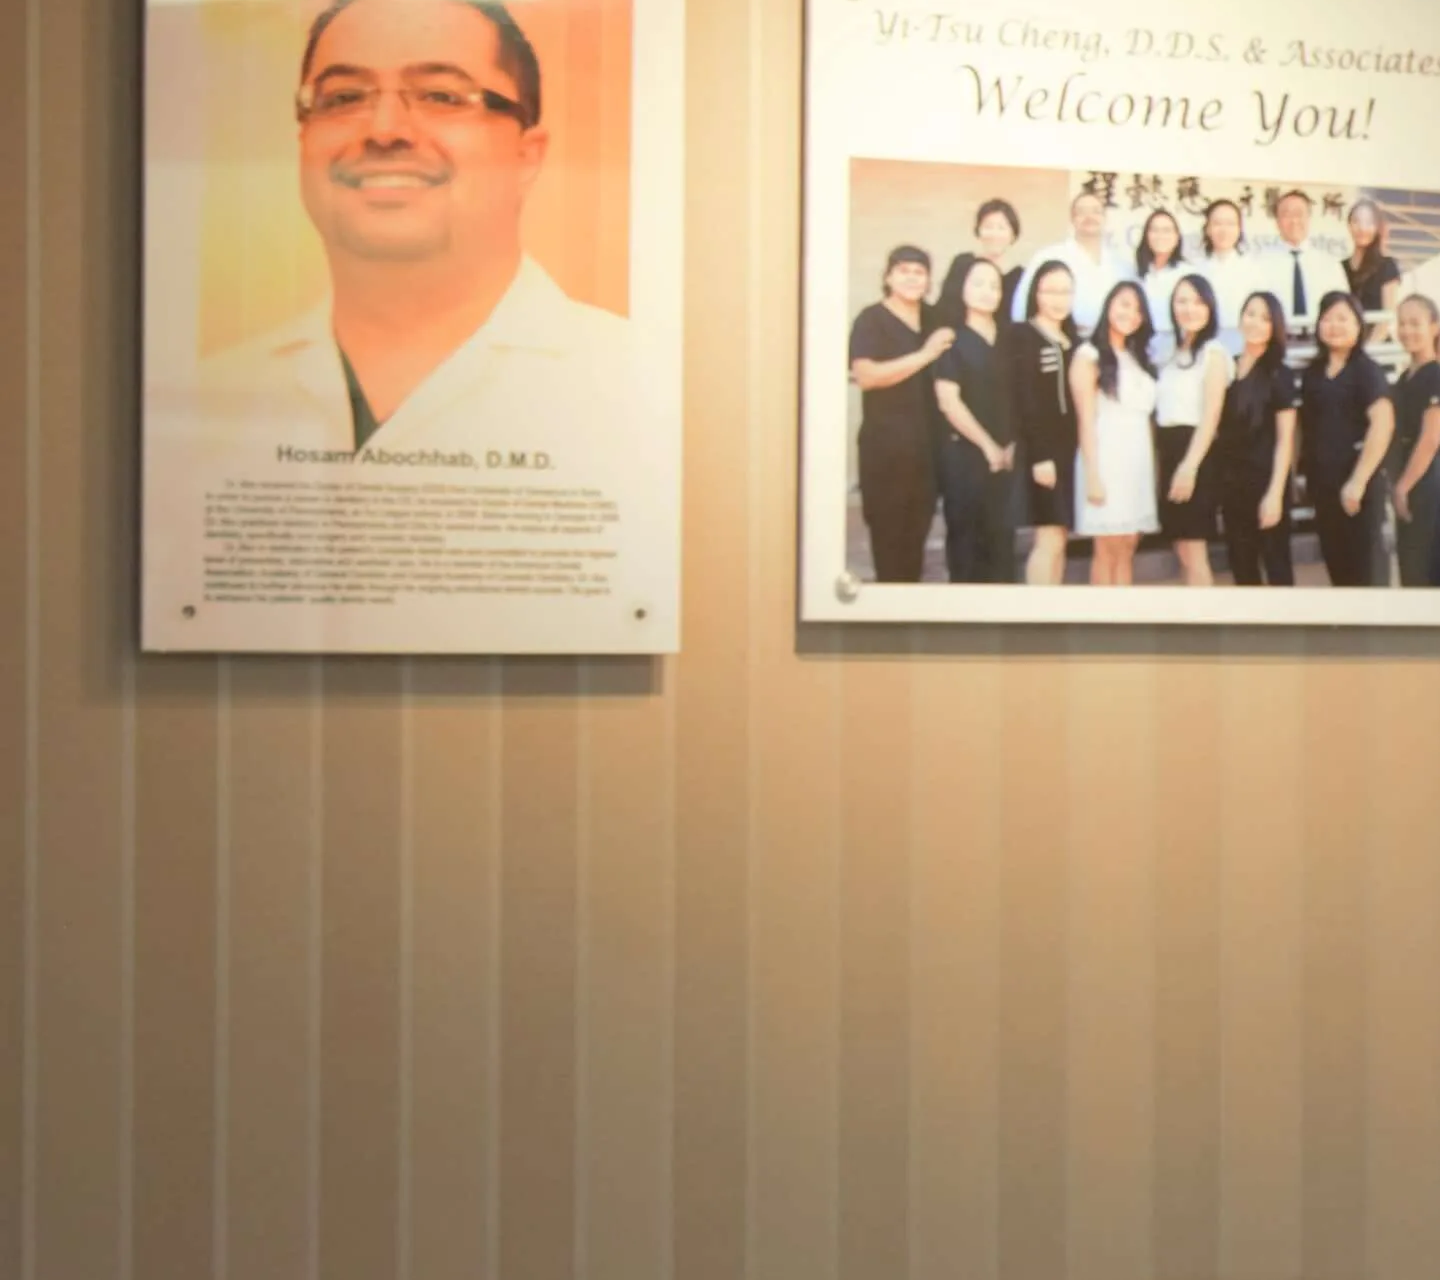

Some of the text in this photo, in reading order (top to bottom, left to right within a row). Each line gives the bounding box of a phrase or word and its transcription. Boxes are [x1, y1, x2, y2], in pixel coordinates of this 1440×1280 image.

[873, 9, 986, 45] Yi-Tsu
[997, 19, 1111, 62] Cheng,
[1241, 34, 1267, 65] &
[960, 64, 1378, 147] Welcome You!
[276, 446, 356, 464] Hosam
